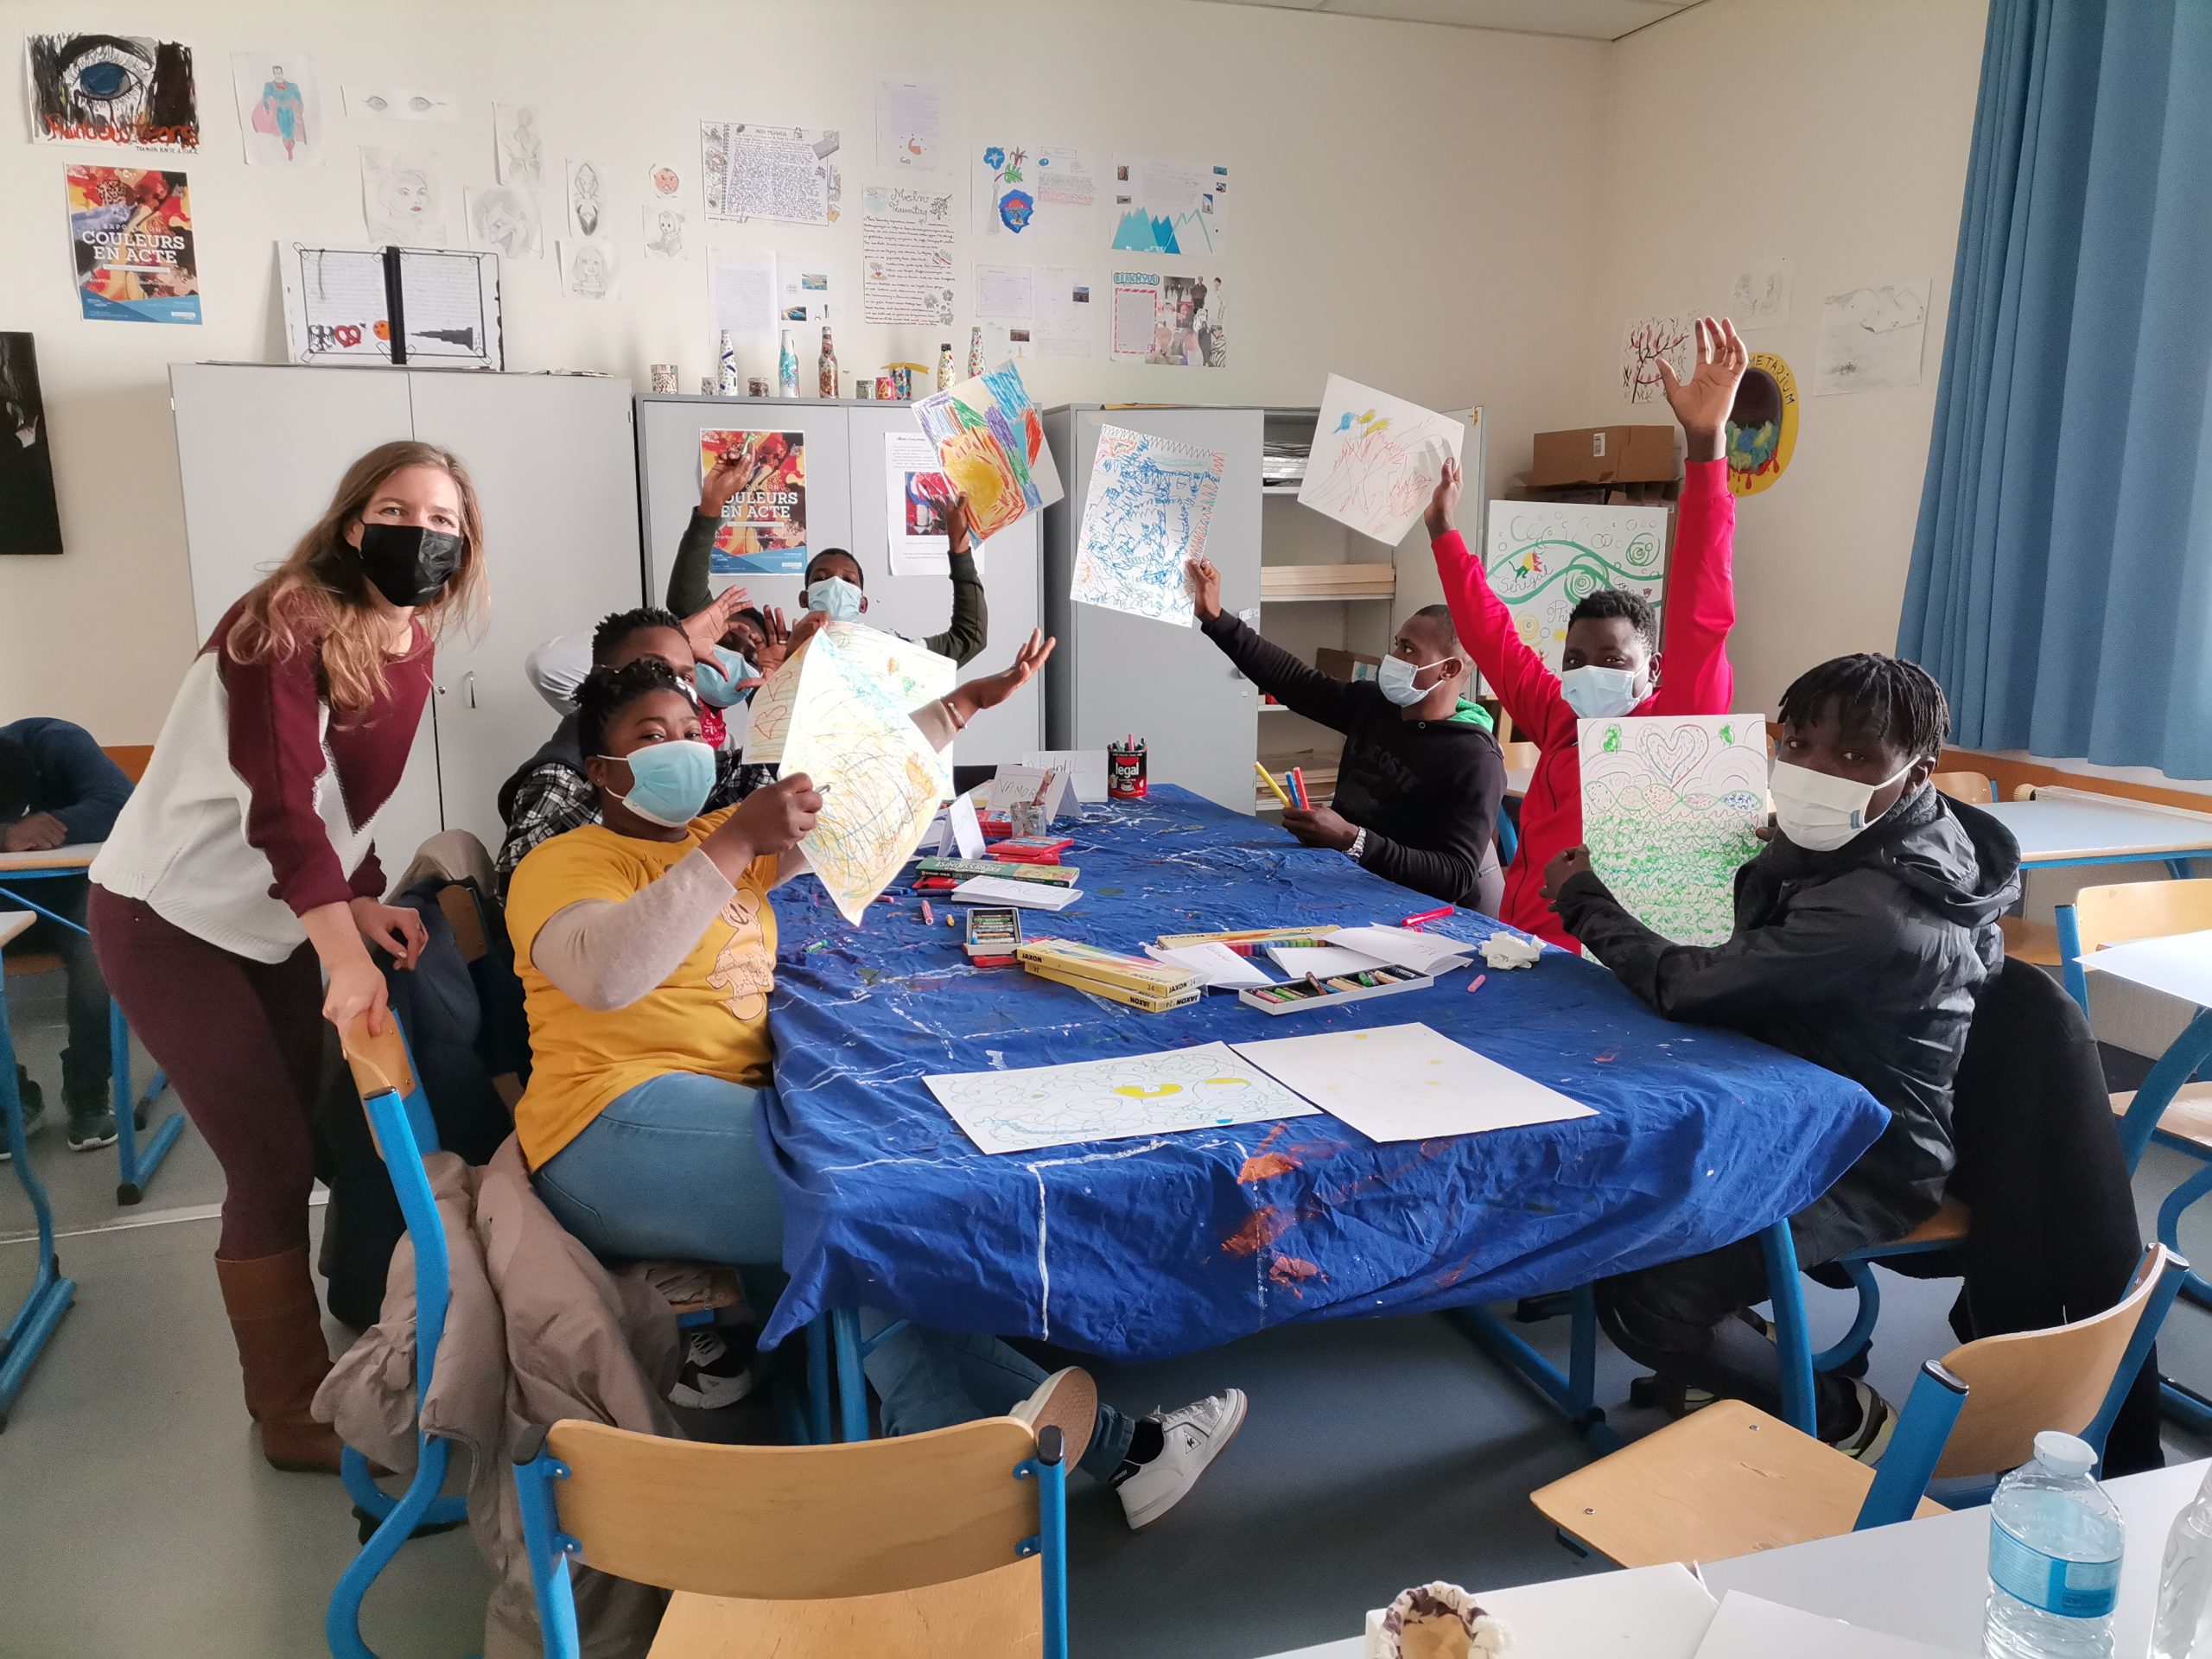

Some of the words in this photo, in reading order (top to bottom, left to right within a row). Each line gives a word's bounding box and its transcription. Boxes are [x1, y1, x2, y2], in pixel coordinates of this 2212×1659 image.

[82, 231, 185, 250] COULEURS
[92, 246, 120, 260] EN
[127, 248, 178, 264] ACTE
[725, 492, 798, 504] OULEURS
[721, 505, 742, 518] EN
[747, 505, 791, 518] ACTE
[1116, 761, 1139, 779] legal
[1350, 736, 1421, 792] LCOSTE
[1021, 953, 1042, 963] JAXON
[1147, 983, 1155, 992] 24
[1168, 982, 1187, 994] JAXON
[1129, 996, 1151, 1008] JAXON
[1176, 995, 1199, 1006] JAXON
